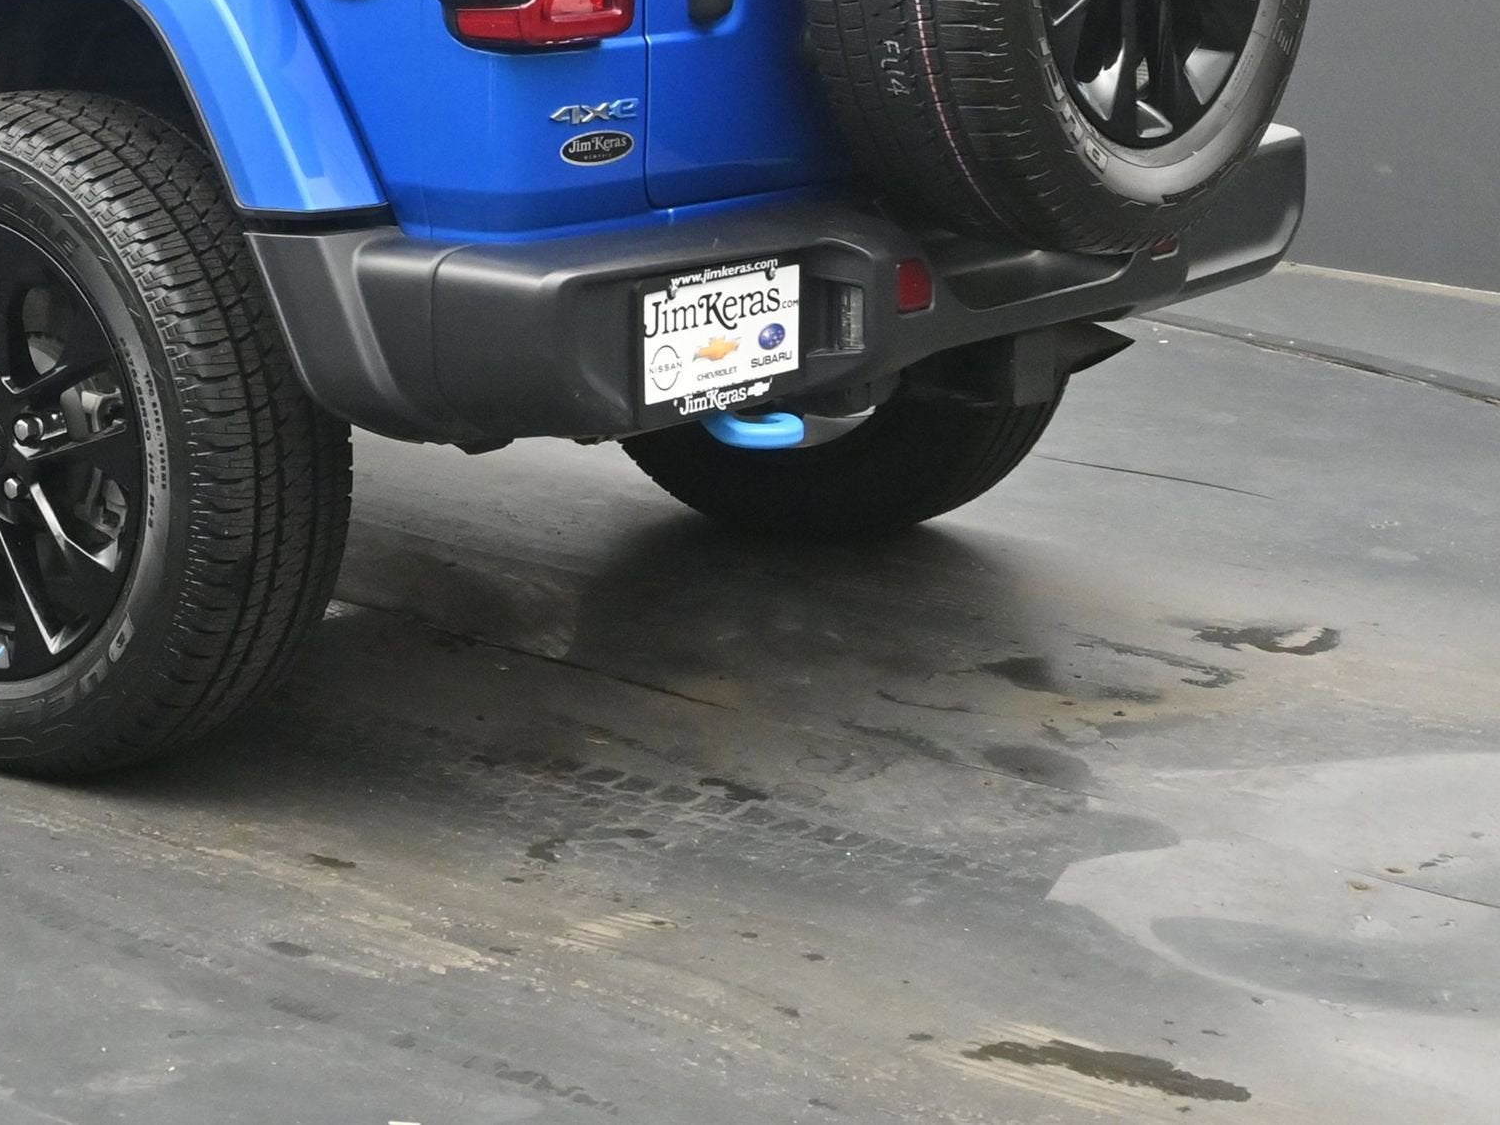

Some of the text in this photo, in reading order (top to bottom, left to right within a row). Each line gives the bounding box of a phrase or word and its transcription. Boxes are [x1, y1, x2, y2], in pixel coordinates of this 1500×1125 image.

[670, 258, 778, 286] www.jimkeras.com
[649, 361, 683, 374] NISSAN
[751, 351, 792, 368] SUBARU
[696, 366, 738, 381] CHEVROLET
